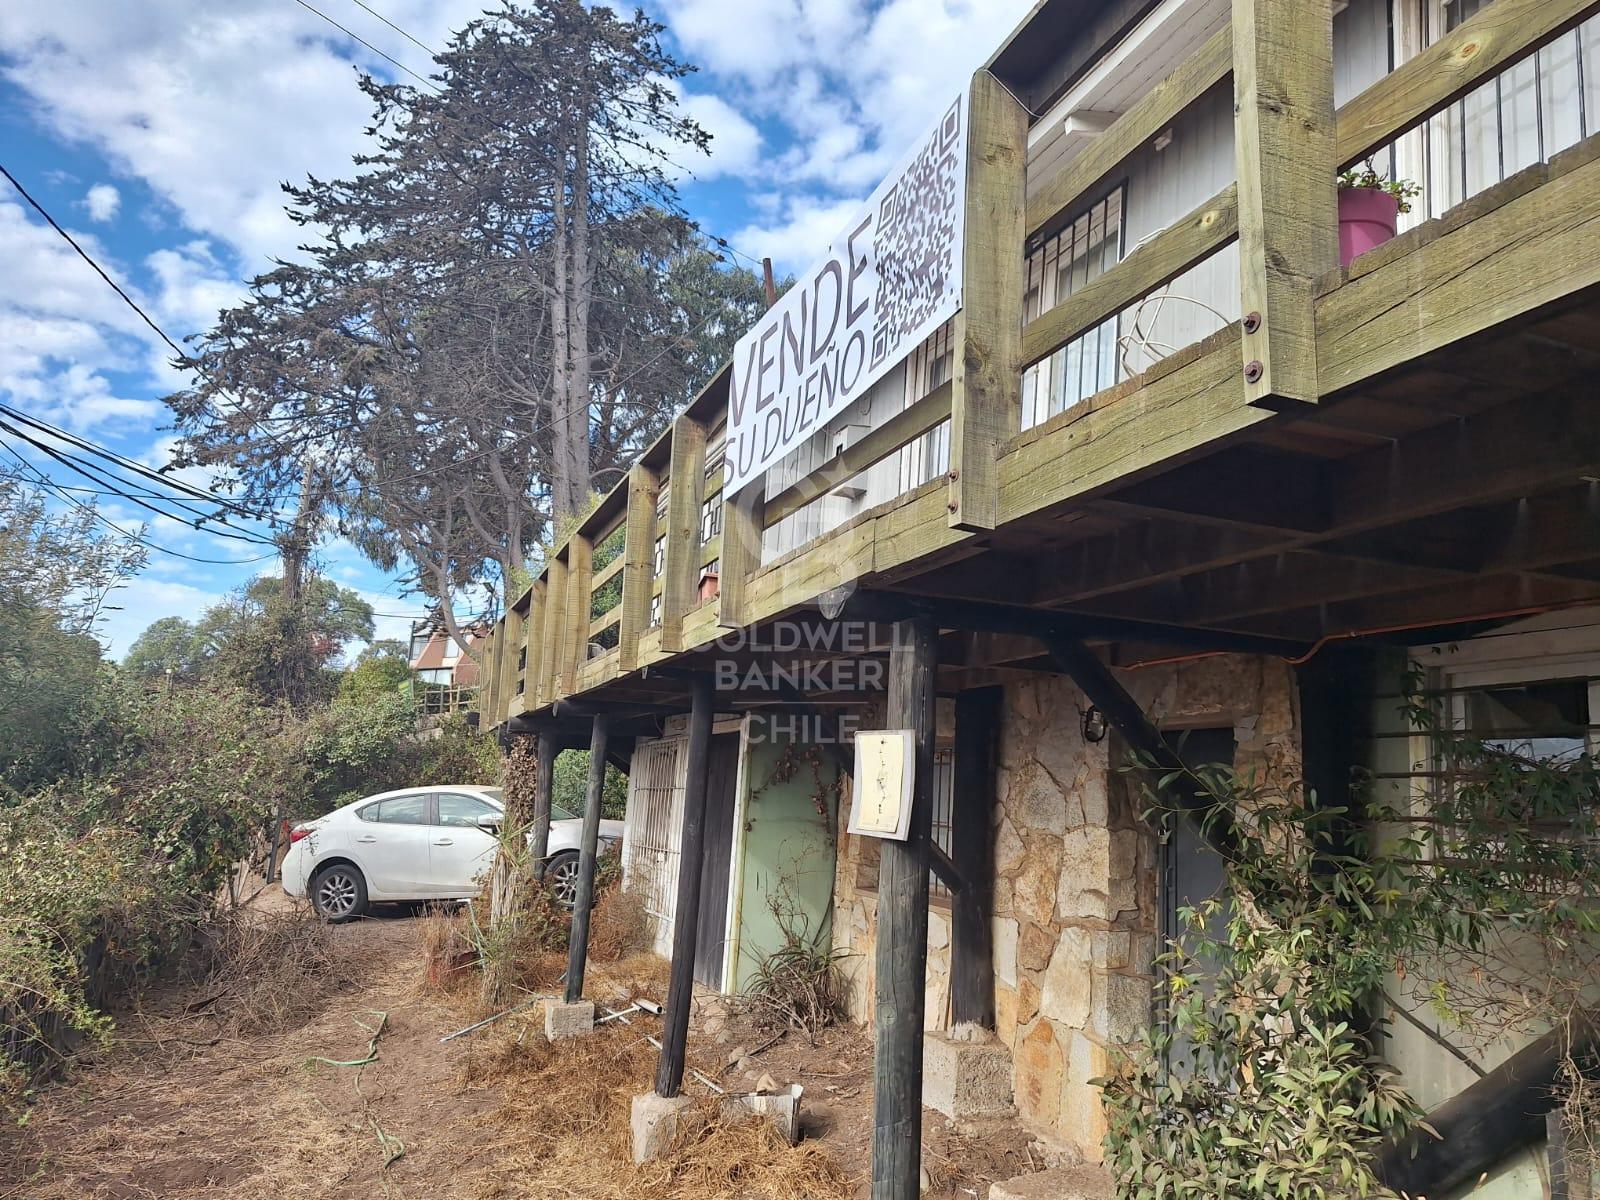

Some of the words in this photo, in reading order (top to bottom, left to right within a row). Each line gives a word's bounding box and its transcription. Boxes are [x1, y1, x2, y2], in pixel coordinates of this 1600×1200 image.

[723, 423, 757, 489] SU
[761, 329, 866, 464] DUEÑO
[729, 213, 873, 428] VENDE
